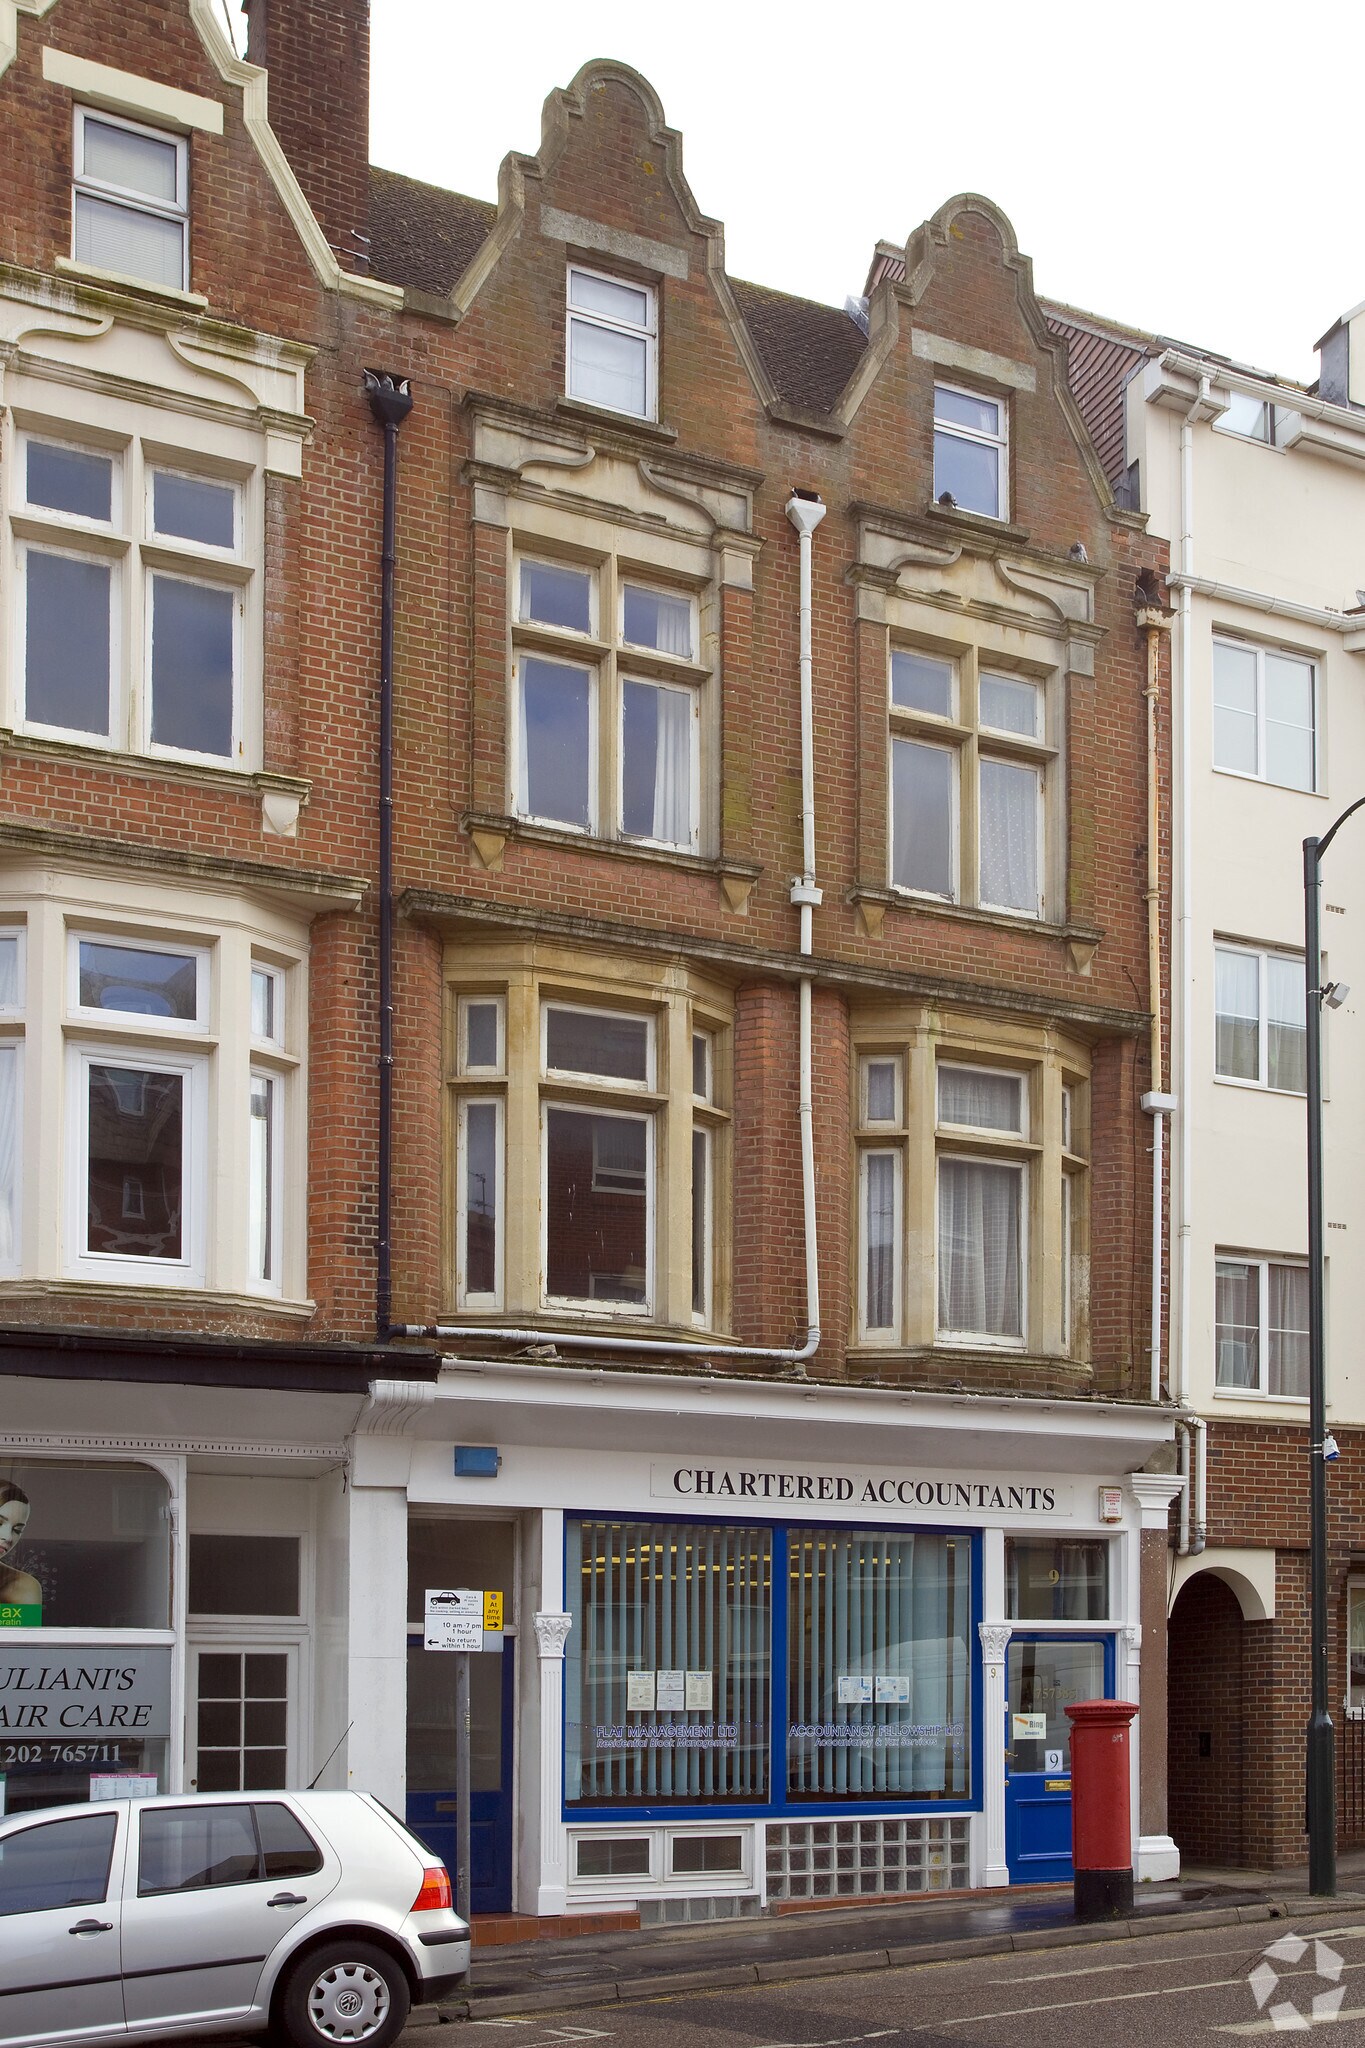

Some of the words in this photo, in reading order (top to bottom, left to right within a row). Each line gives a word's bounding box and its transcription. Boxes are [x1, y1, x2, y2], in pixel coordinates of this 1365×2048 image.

[673, 1468, 854, 1501] CHARTERED
[860, 1478, 1056, 1511] ACCOUNTANTS
[1048, 1570, 1060, 1586] 9
[991, 1667, 996, 1678] 9
[59, 1704, 152, 1728] CARE
[596, 1726, 624, 1738] FLAT
[628, 1726, 714, 1738] MANAGEMENT
[718, 1726, 737, 1738] LTD
[789, 1725, 876, 1737] ACCOUNTANCY
[878, 1725, 941, 1737] FELLOWSHIP
[945, 1725, 963, 1737] LTD
[596, 1738, 648, 1748] Residential
[650, 1738, 674, 1748] Block
[677, 1738, 737, 1748] Management
[814, 1738, 873, 1747] Accountancy
[875, 1738, 882, 1746] &
[884, 1738, 899, 1746] Tax
[901, 1738, 937, 1746] Services
[0, 1745, 42, 1763] 202
[50, 1744, 121, 1763] 765711
[1050, 1753, 1059, 1769] 9
